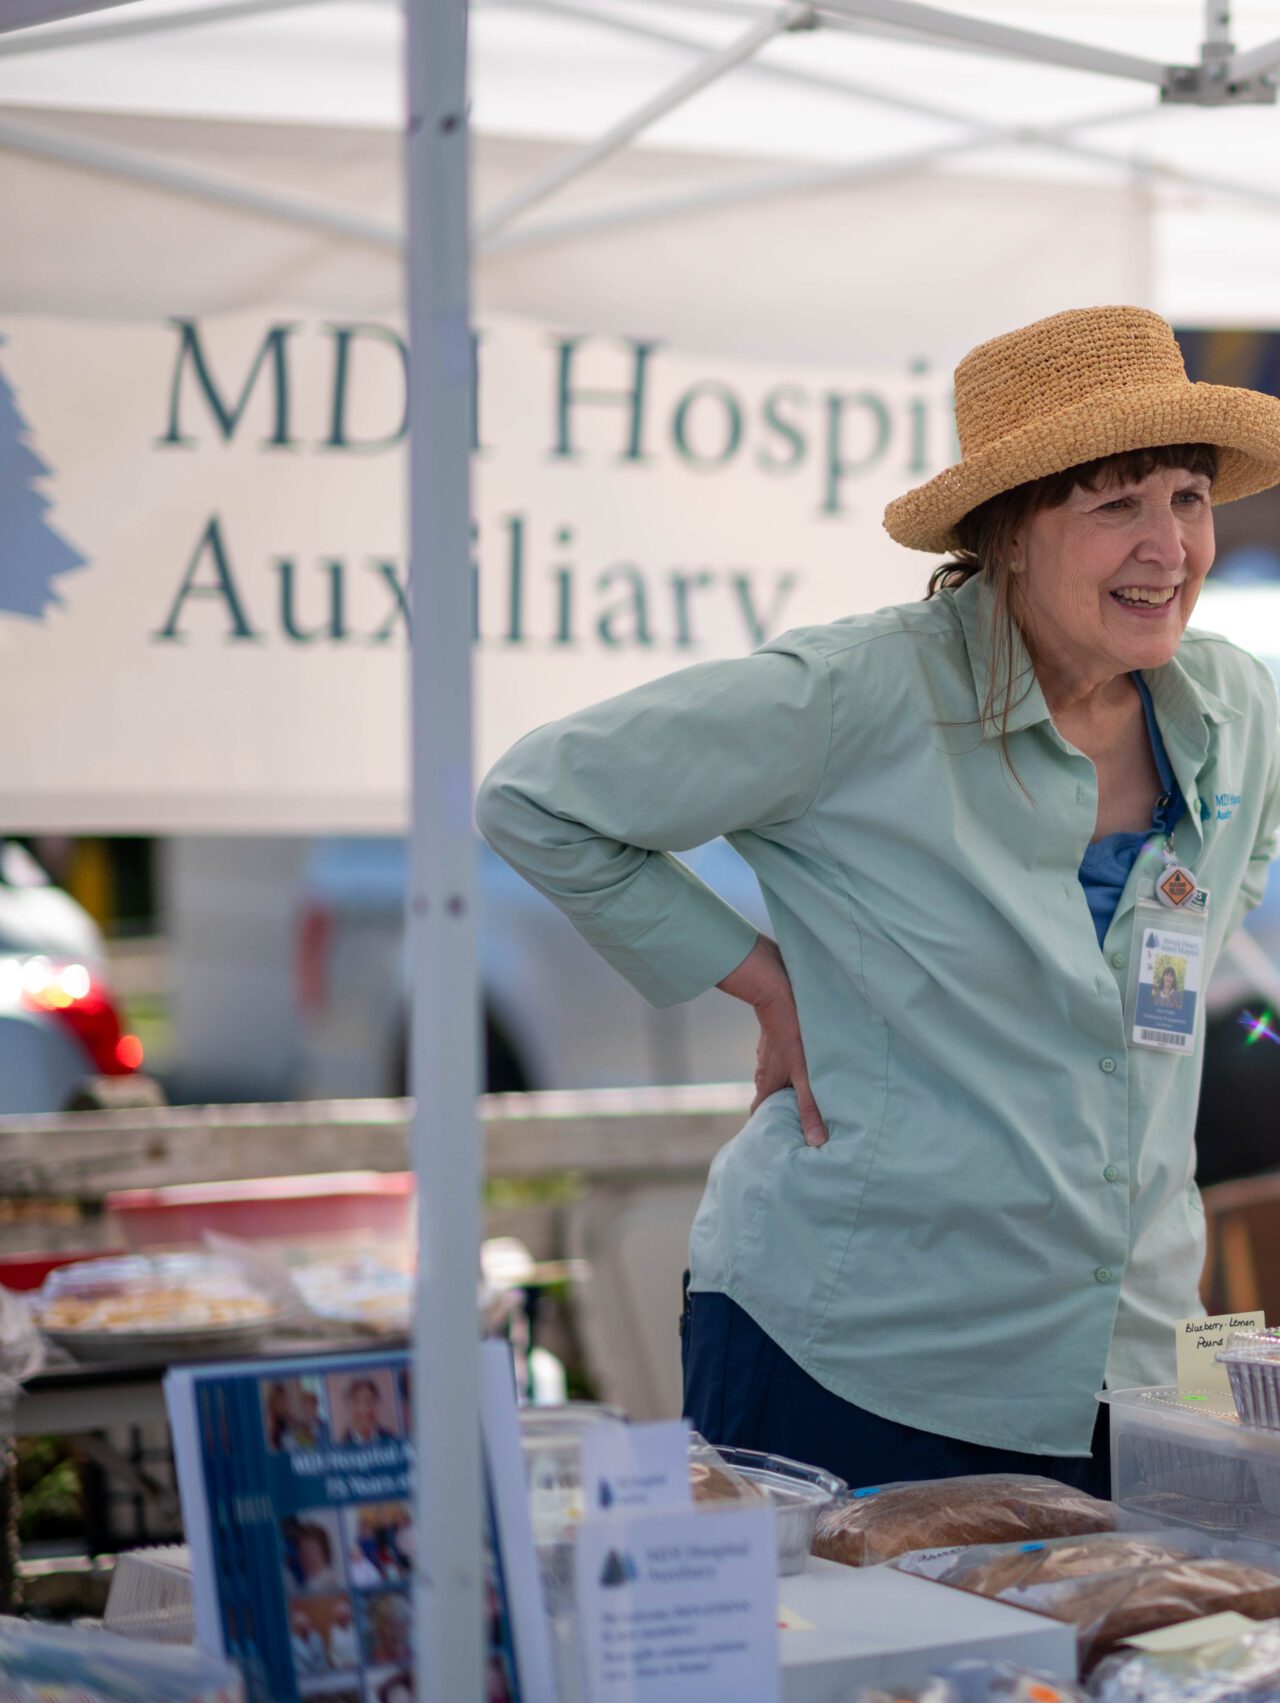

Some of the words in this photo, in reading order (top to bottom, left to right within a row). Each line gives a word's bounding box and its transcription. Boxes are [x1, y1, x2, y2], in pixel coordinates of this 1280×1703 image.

[154, 315, 490, 455] MDI
[543, 334, 960, 515] Hospi
[1196, 1336, 1224, 1349] Pound
